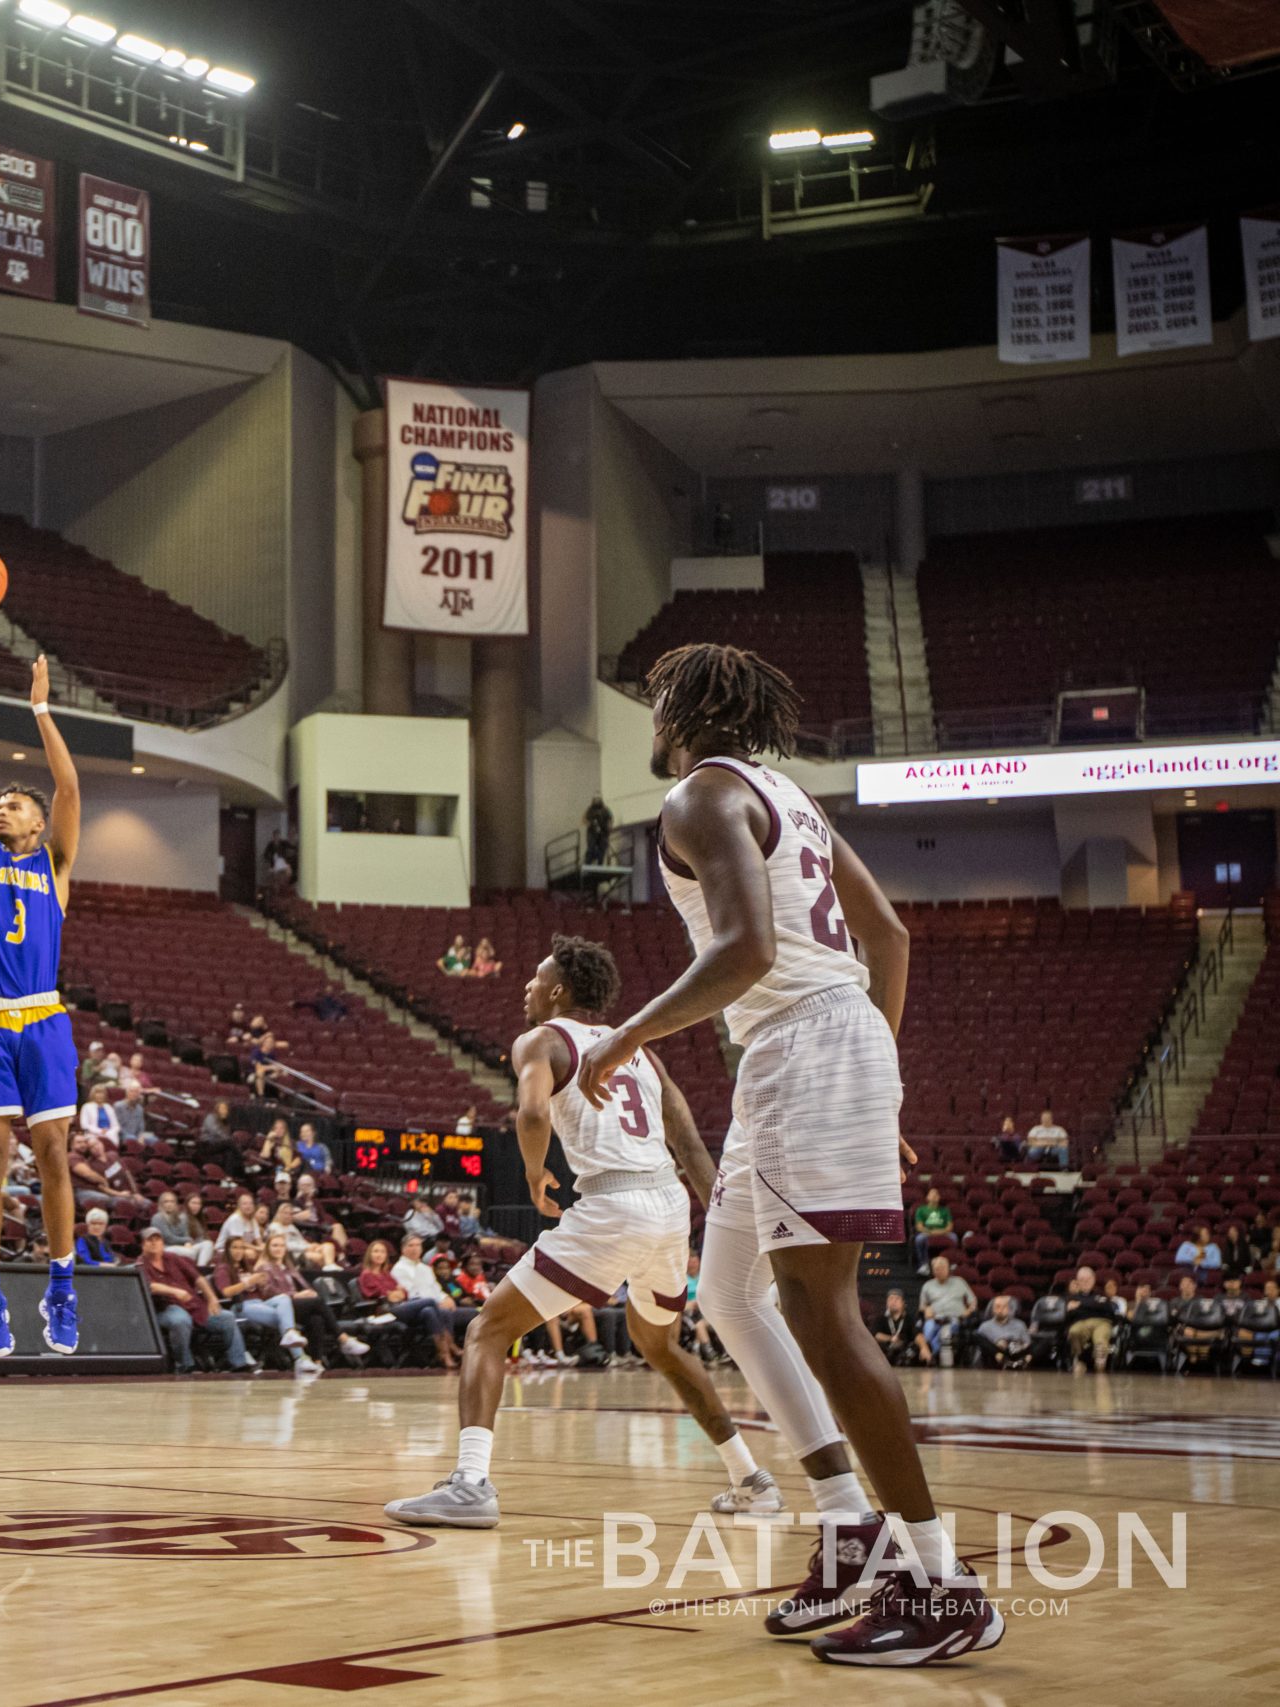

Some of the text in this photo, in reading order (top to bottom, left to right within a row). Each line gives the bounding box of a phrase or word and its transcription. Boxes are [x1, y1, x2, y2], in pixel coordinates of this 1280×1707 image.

[86, 207, 145, 258] 800
[87, 257, 145, 296] WINS
[413, 403, 501, 429] NATIONAL
[400, 424, 514, 452] CHAMPIONS
[436, 462, 508, 494] FINAL
[1082, 479, 1124, 500] 211
[770, 489, 817, 510] 210
[421, 546, 494, 580] 2011
[905, 760, 1027, 780] AGGIELAND
[1081, 754, 1278, 781] aggielandcu.org
[800, 846, 848, 953] 2
[5, 899, 27, 944] 3
[608, 1074, 650, 1138] 3
